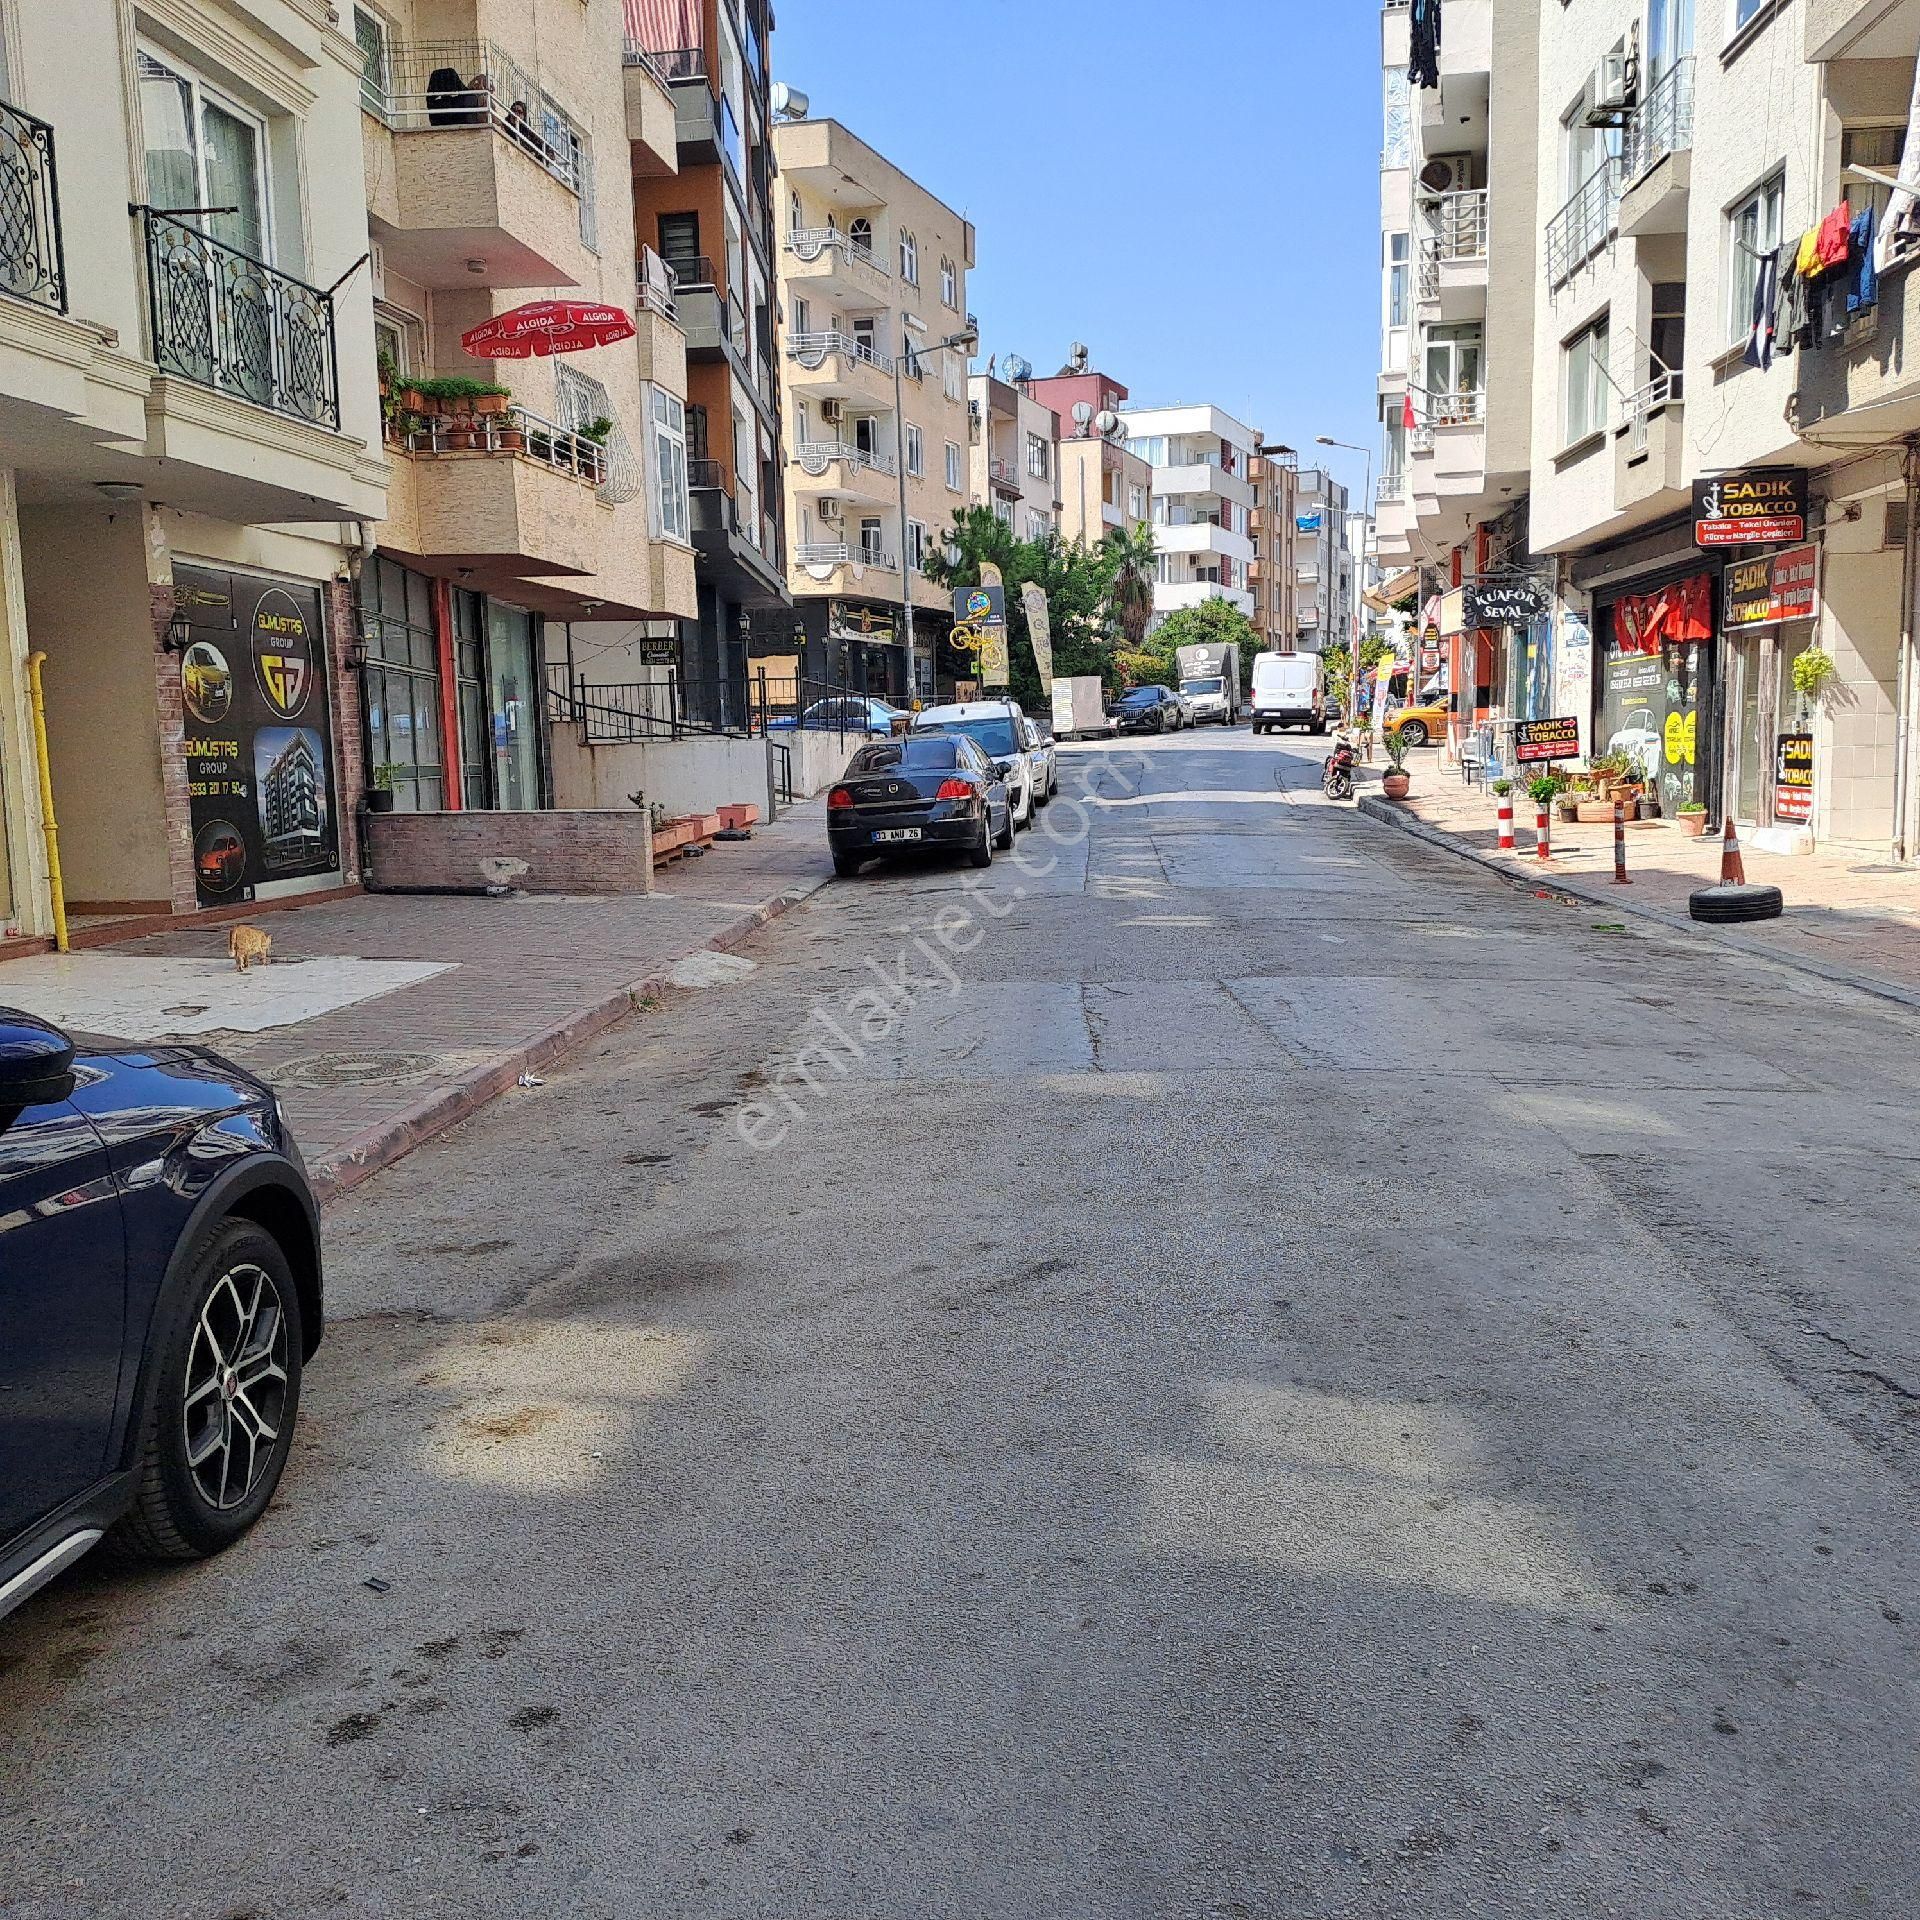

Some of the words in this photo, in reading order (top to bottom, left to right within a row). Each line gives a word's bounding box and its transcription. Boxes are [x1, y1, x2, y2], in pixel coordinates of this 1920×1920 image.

[516, 316, 555, 331] ALGIDA
[582, 312, 615, 322] ALGIDA
[470, 326, 493, 343] ALGIDA
[1723, 480, 1793, 500] SADIK
[1720, 500, 1797, 517] TOBACCO
[1733, 562, 1768, 593] SADIK
[1732, 599, 1770, 622] TOBACCO
[270, 636, 294, 649] GROUP
[1528, 721, 1563, 732] SADIK
[1528, 730, 1576, 742] TOBACCO
[200, 762, 228, 774] GROUP
